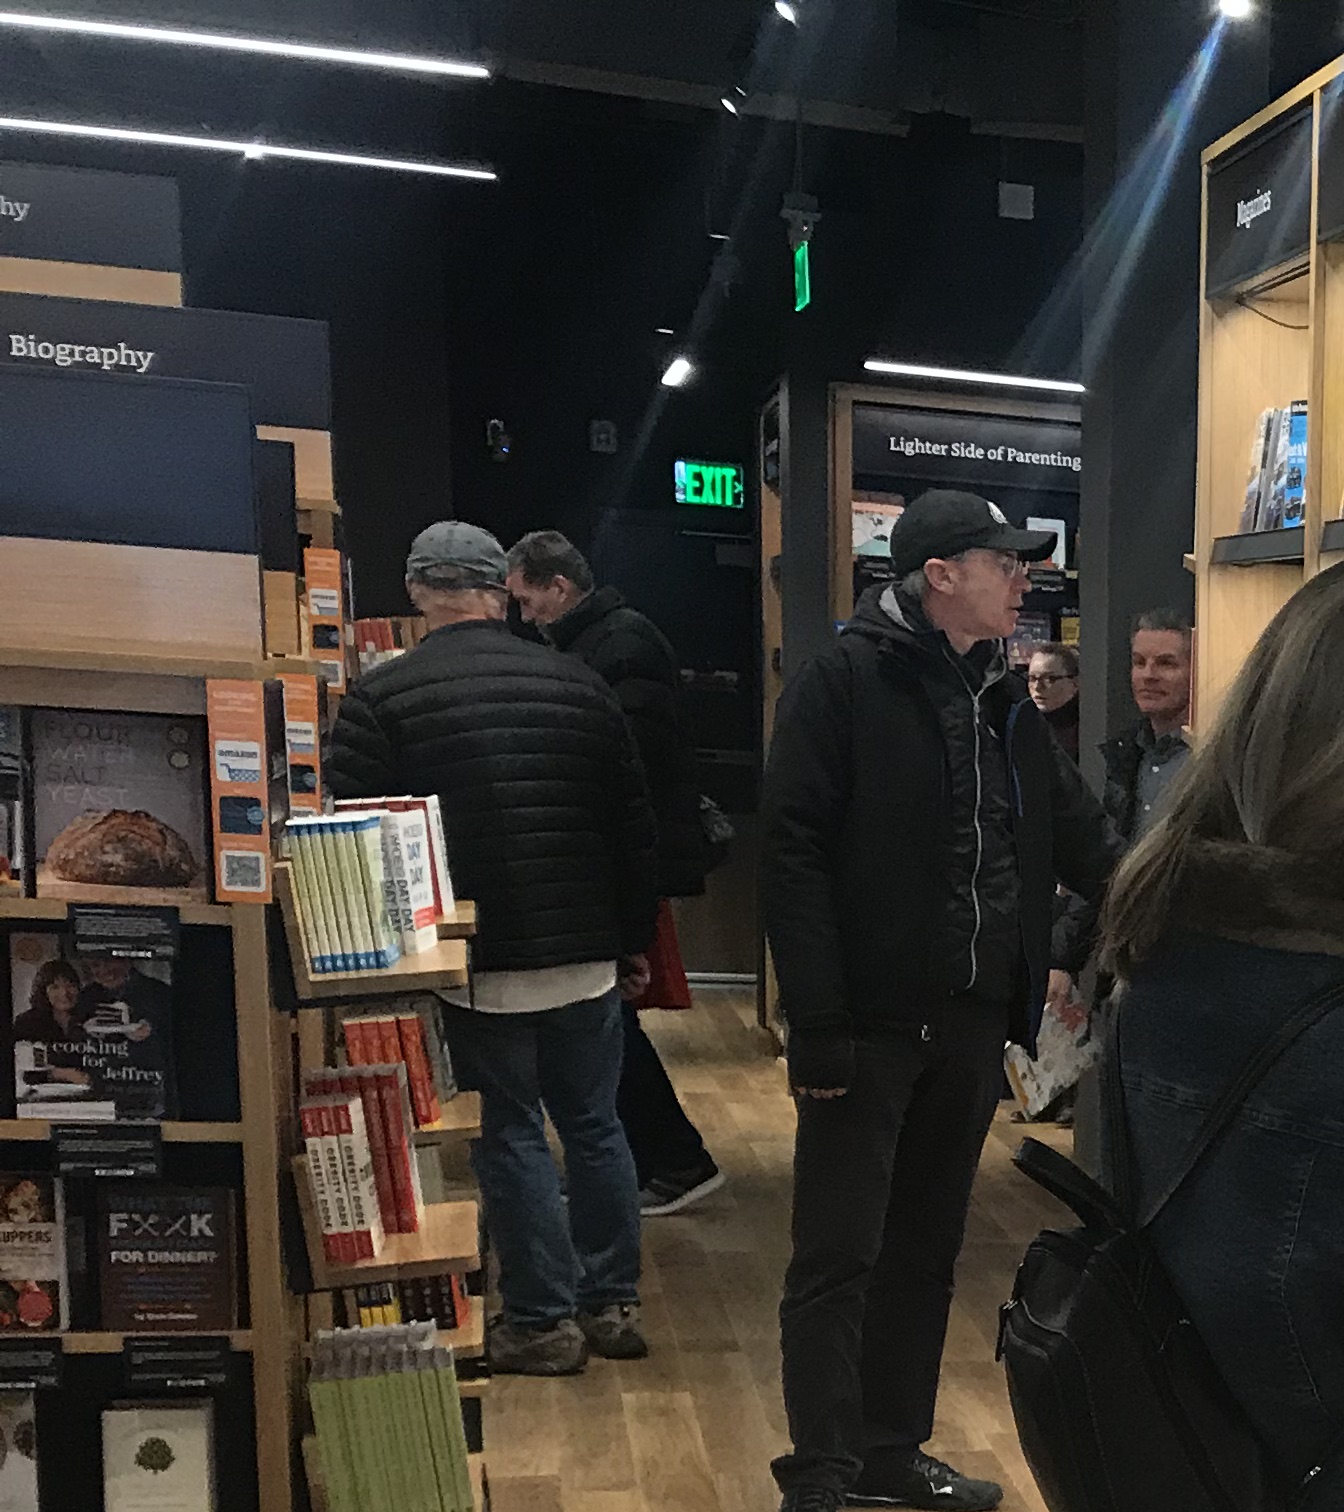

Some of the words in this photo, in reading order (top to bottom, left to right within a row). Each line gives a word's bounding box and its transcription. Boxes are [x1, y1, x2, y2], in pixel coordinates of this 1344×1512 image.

[1237, 189, 1272, 229] Magazines
[10, 333, 155, 373] Biography
[889, 436, 948, 458] Lighter
[951, 442, 984, 461] Side
[987, 445, 1005, 462] of
[1006, 446, 1082, 472] Parenting
[686, 466, 736, 507] EXIT
[52, 1037, 129, 1058] cooking
[81, 1053, 109, 1068] for
[101, 1064, 164, 1086] Jeffrey
[111, 1249, 145, 1263] FOR
